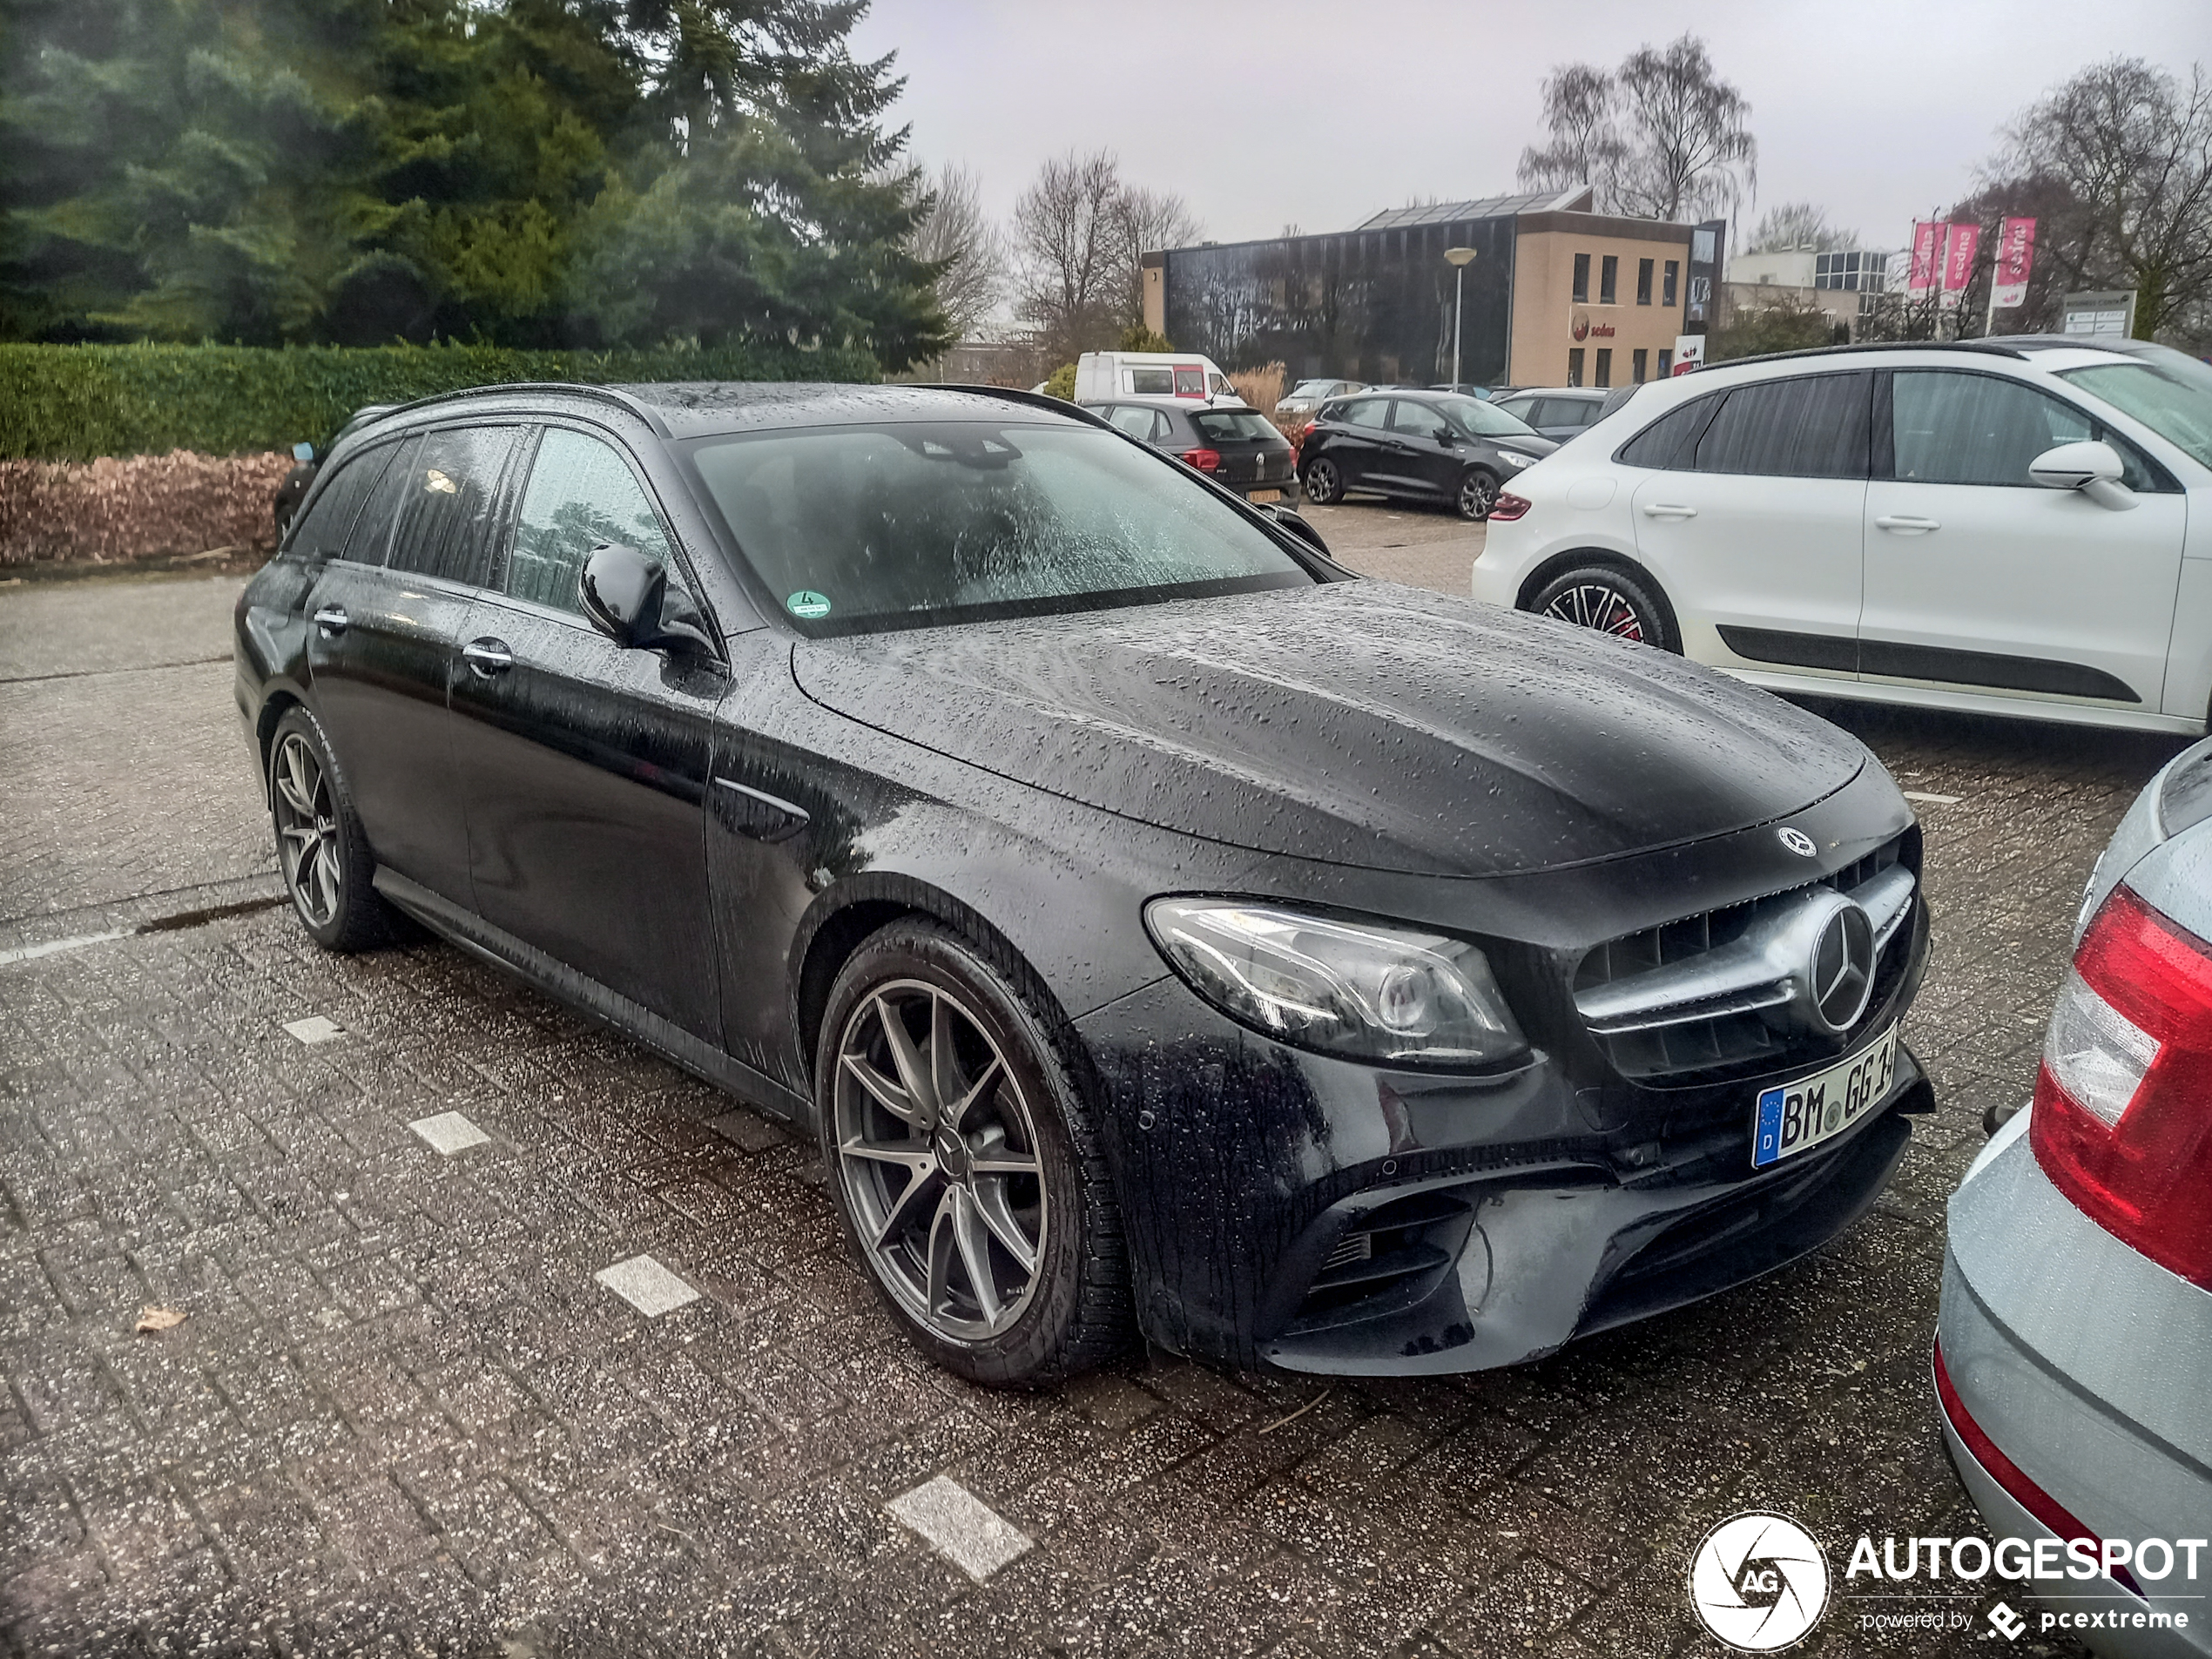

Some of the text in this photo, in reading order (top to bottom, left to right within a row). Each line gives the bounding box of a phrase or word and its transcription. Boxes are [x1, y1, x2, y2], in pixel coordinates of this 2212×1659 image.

[1954, 230, 1972, 280] sedna
[1591, 322, 1615, 337] sedna
[801, 592, 813, 604] 4
[1781, 1082, 1825, 1150] BM
[1844, 1054, 1874, 1119] GG
[1763, 1134, 1772, 1150] D
